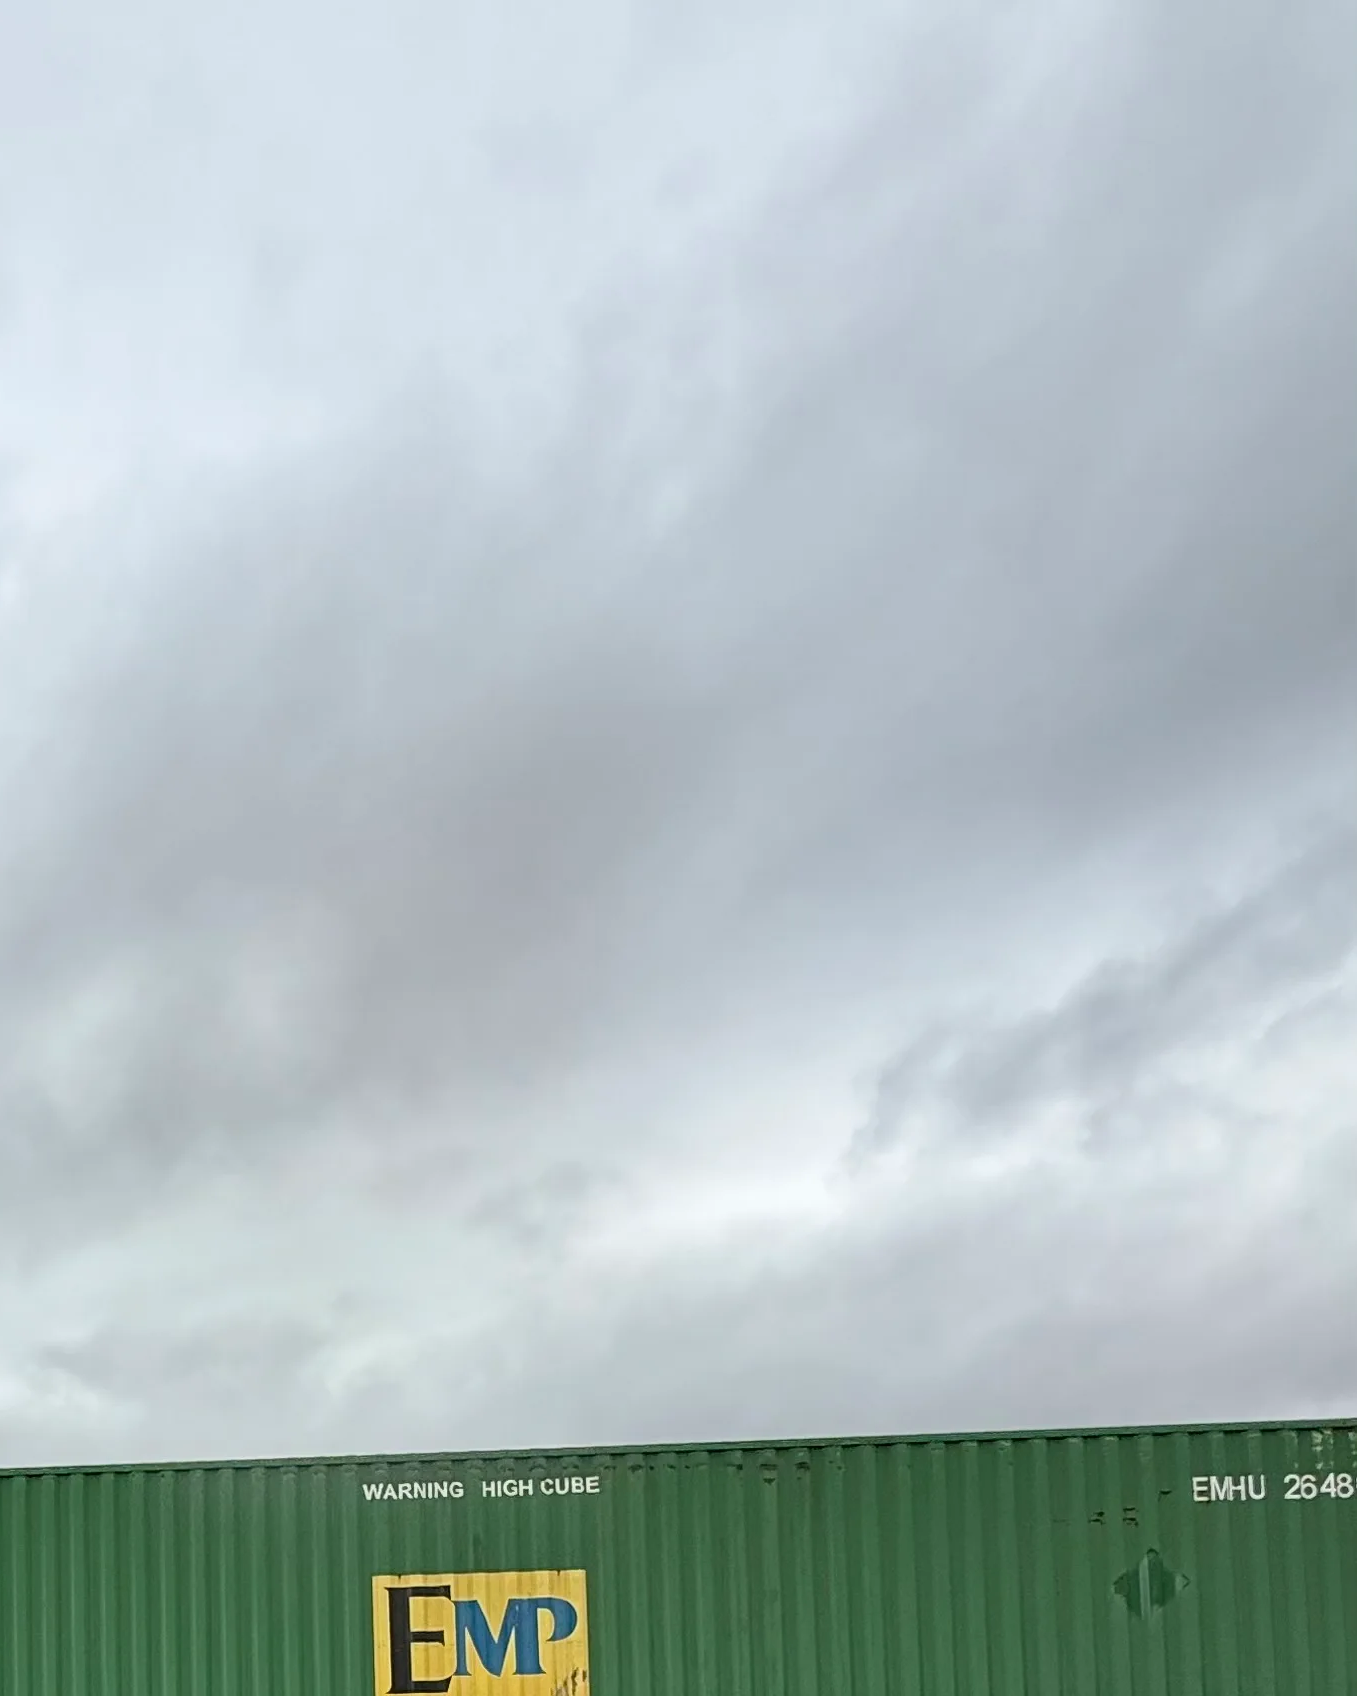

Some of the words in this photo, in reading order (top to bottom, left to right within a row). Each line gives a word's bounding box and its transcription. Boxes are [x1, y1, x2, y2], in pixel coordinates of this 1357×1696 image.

[362, 1481, 464, 1501] WARNING
[482, 1479, 533, 1498] HIGH
[540, 1476, 600, 1495] CUBE
[1192, 1474, 1266, 1502] EMHU
[1284, 1473, 1357, 1500] 2648
[384, 1585, 578, 1694] EMP
